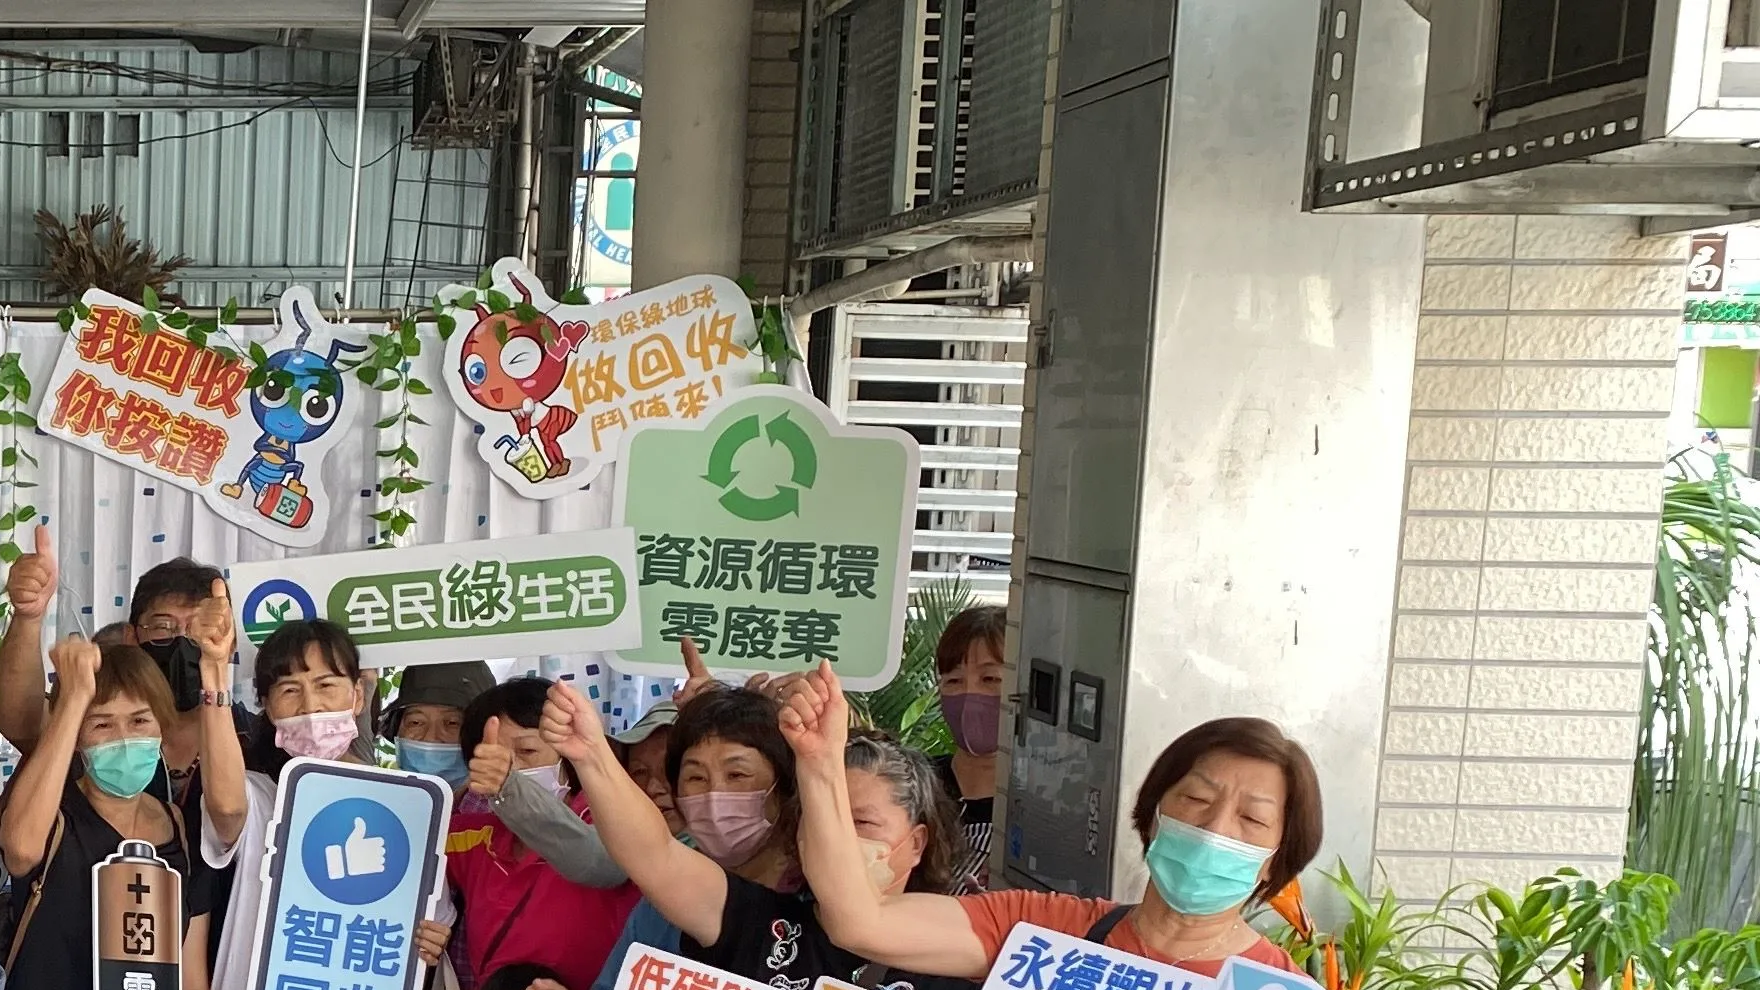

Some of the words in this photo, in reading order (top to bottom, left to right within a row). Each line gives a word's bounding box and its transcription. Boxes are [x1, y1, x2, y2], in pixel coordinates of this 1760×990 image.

[590, 284, 716, 344] 環保綠地球
[78, 304, 250, 416] 我回收
[565, 310, 747, 414] 做回收
[52, 369, 228, 486] 你按讚
[344, 558, 616, 634] 全民綠生活
[637, 532, 880, 600] 資源循環
[661, 600, 843, 663] 零廢棄
[282, 904, 404, 977] 智能
